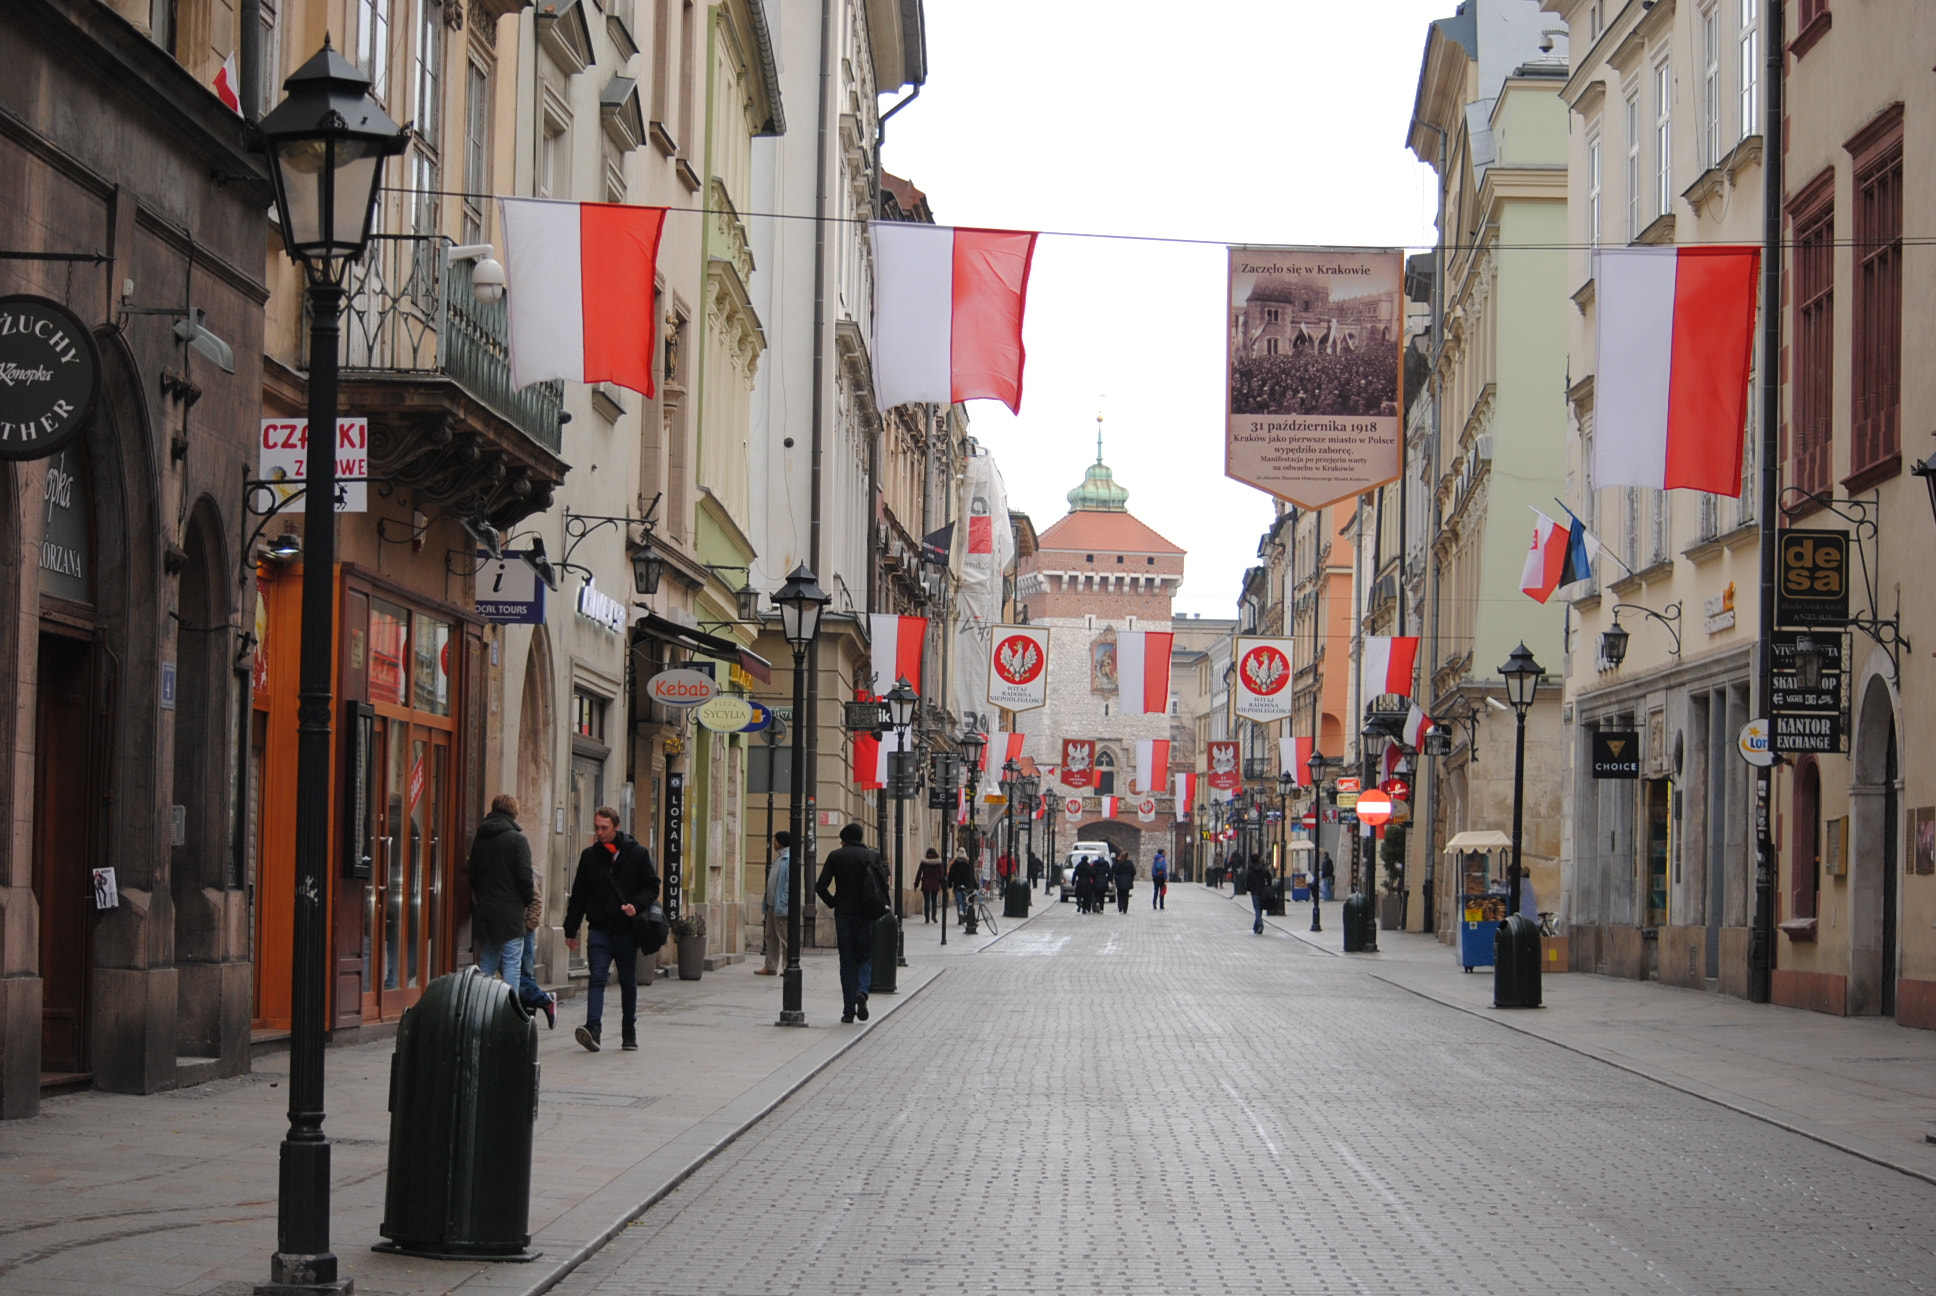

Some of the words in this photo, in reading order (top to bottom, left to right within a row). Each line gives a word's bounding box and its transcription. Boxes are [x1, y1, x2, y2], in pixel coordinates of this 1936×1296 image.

[1241, 263, 1284, 276] Zaczęło
[1286, 264, 1302, 276] się
[1317, 264, 1371, 275] Krakowie
[1251, 422, 1264, 433] 31
[1267, 420, 1347, 433] października
[1351, 421, 1377, 434] 1918
[262, 423, 366, 450] CZAKI
[1233, 434, 1266, 442] Kraków
[1268, 435, 1287, 444] jako
[1288, 435, 1326, 444] pierwsze
[1328, 435, 1357, 444] miasto
[1368, 436, 1395, 445] Polsce
[1274, 445, 1316, 455] wypędziło
[1318, 446, 1354, 456] zaborcę.
[1260, 455, 1304, 463] Manifestacja
[475, 604, 496, 614] OCAL
[498, 605, 528, 614] TOURS
[655, 680, 711, 697] Kebab
[703, 708, 746, 719] SYCYLIA
[1777, 718, 1831, 735] KANTOR
[1776, 735, 1831, 749] EXCHANGE
[1595, 762, 1637, 771] CHOICE
[670, 795, 680, 852] LOCAL
[669, 862, 679, 921] TOURS
